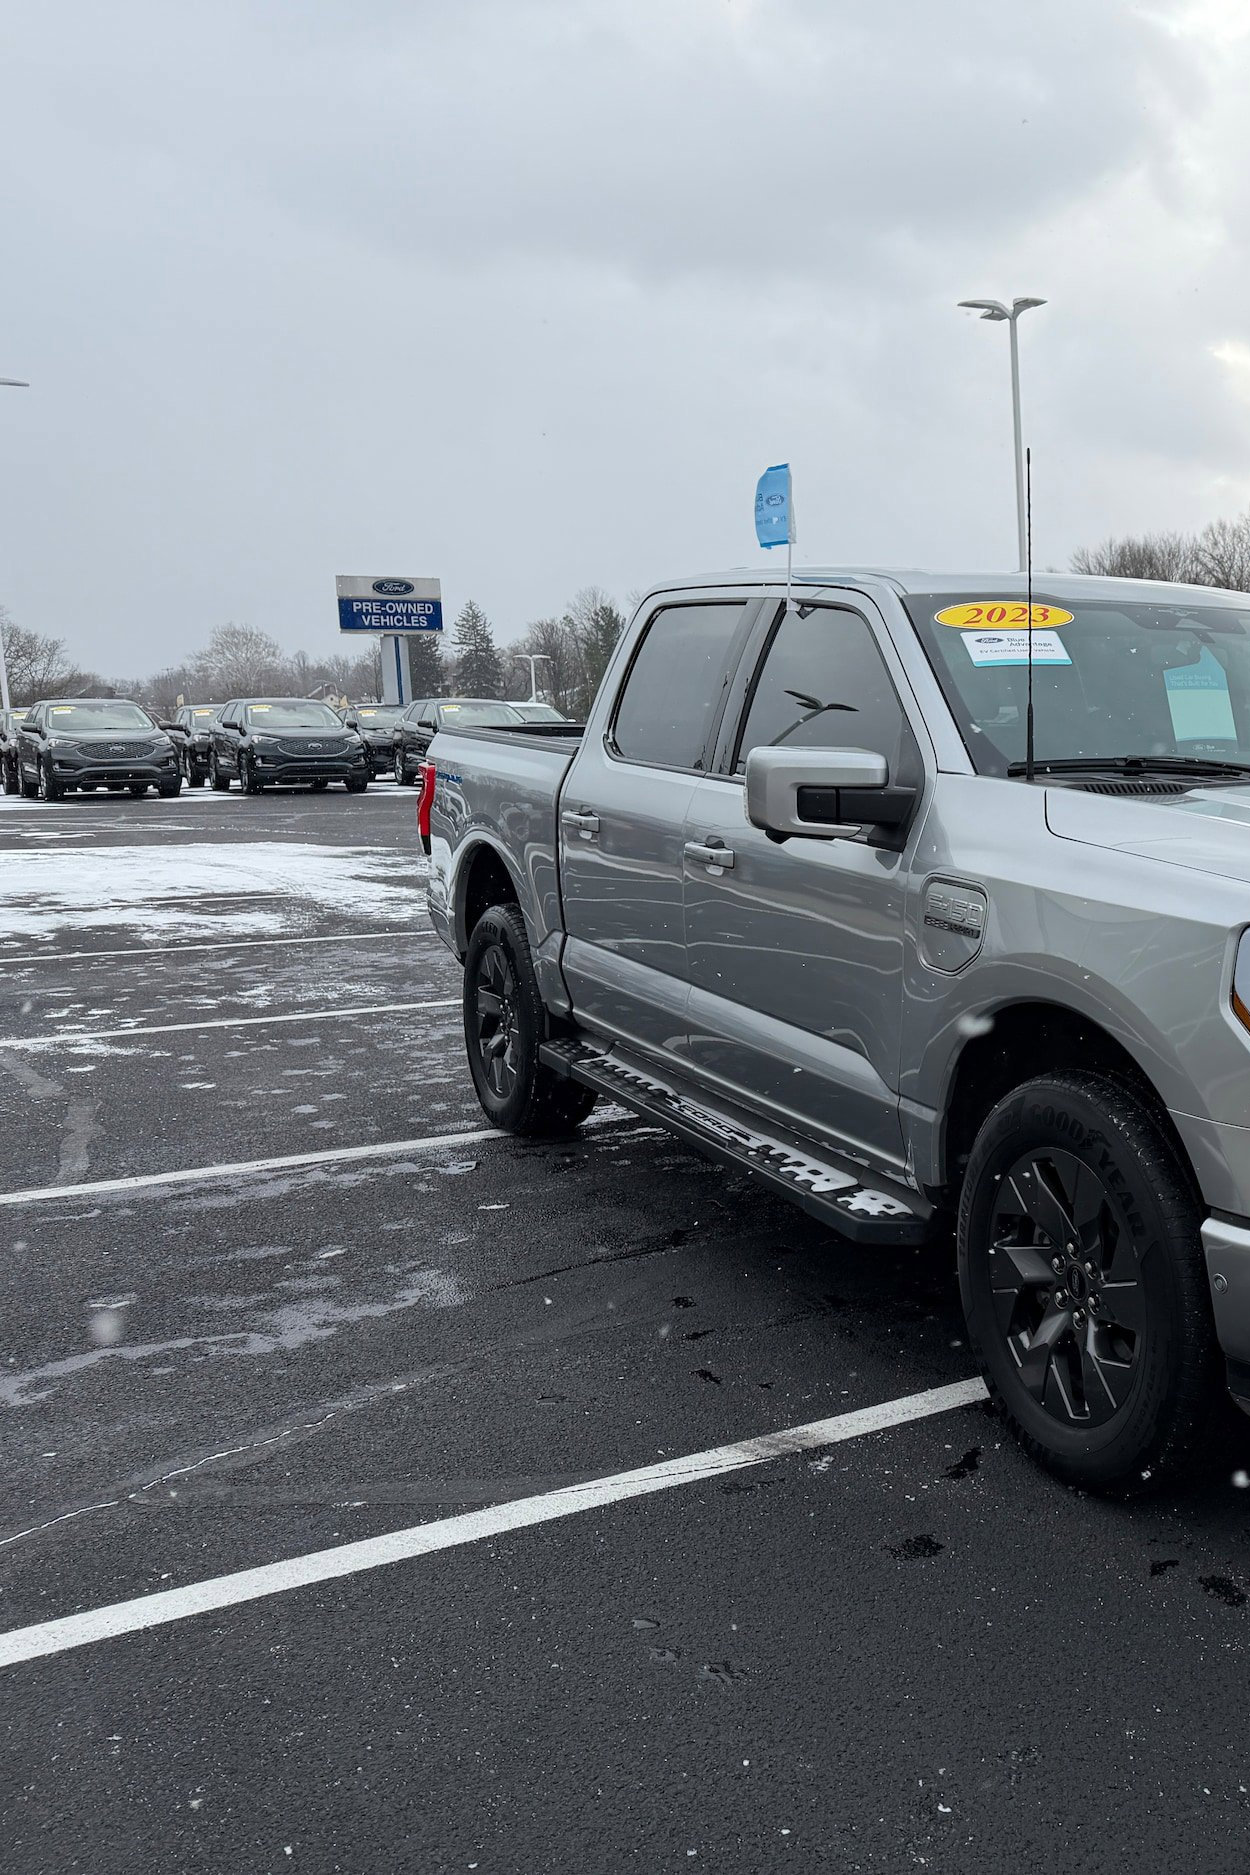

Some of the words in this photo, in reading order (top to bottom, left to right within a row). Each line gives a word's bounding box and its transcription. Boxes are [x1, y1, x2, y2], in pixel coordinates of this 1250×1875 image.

[382, 582, 406, 592] Ford
[352, 602, 434, 614] PRE-OWNED
[962, 606, 1050, 625] 2023
[362, 615, 428, 627] VEHICLES
[677, 1104, 735, 1134] FORD
[1031, 1103, 1146, 1237] GOODYEAR
